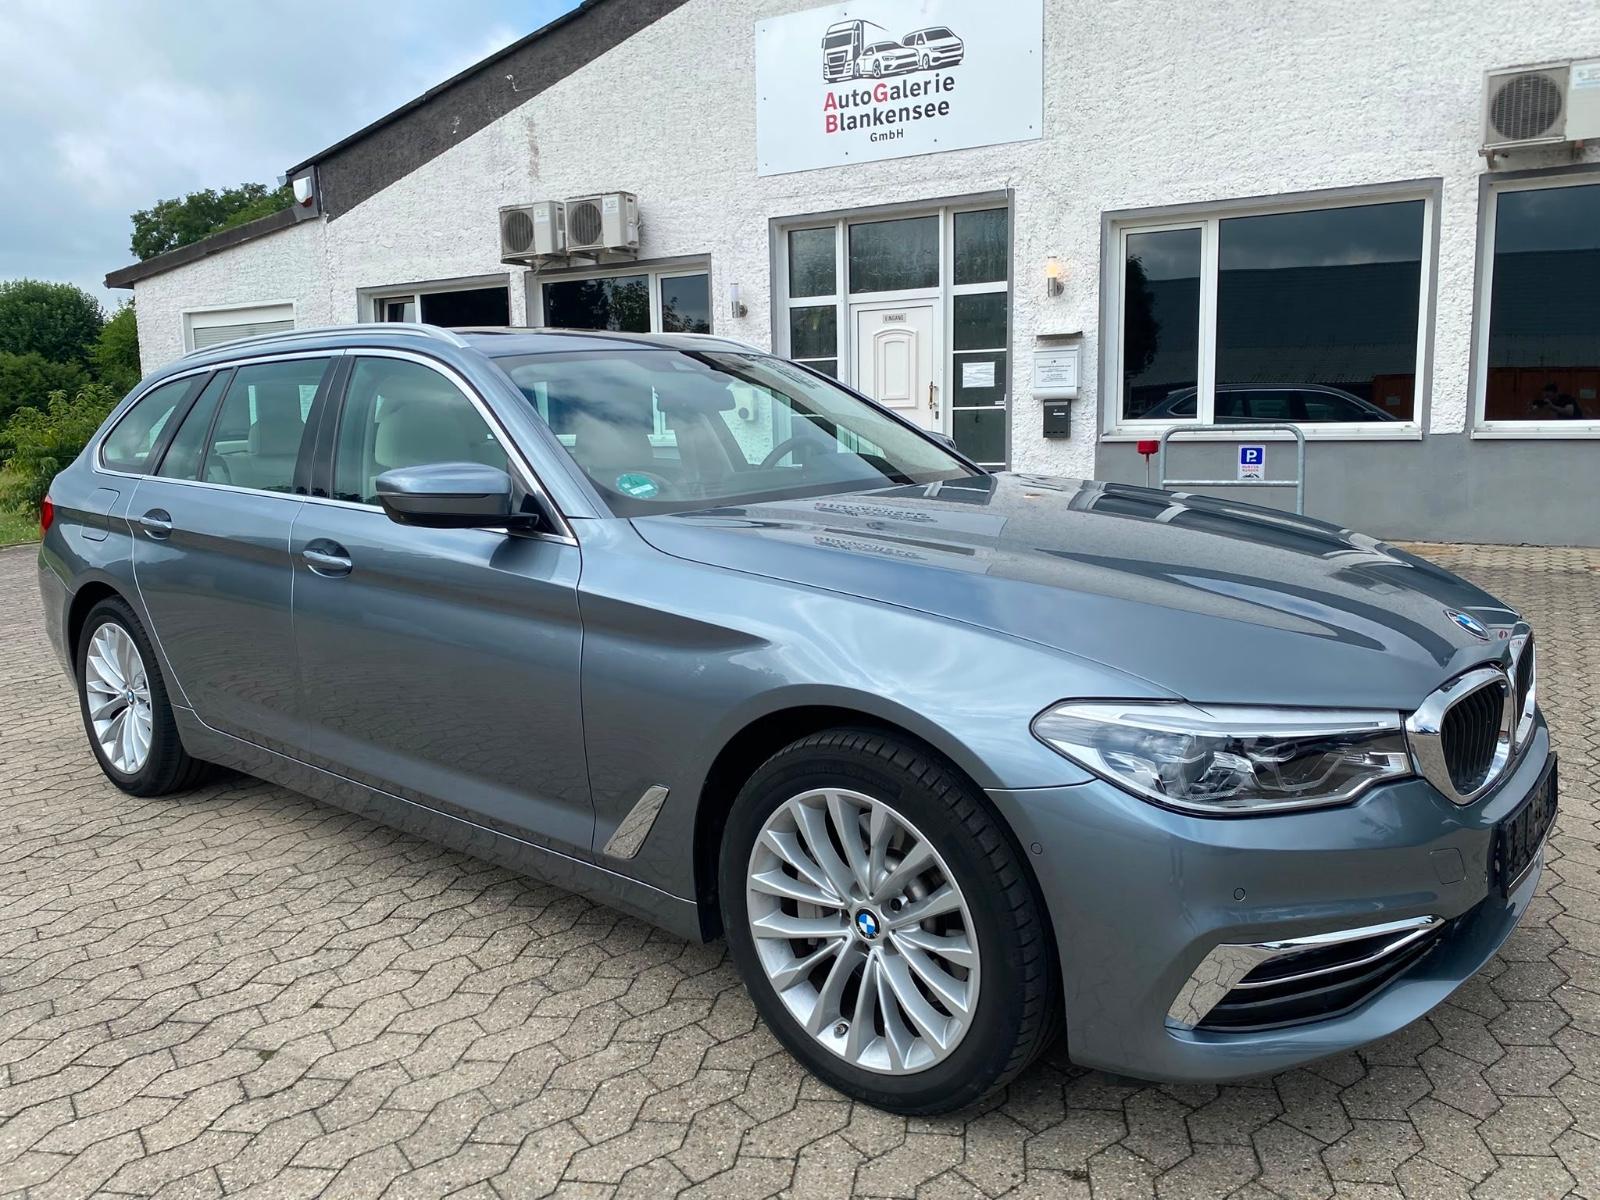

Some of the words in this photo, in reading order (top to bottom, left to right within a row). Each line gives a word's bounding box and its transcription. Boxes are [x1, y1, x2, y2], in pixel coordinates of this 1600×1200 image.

[824, 73, 955, 111] AutoGalerie
[825, 100, 950, 133] Blankensee
[870, 128, 904, 142] GmbH
[1246, 450, 1258, 462] P
